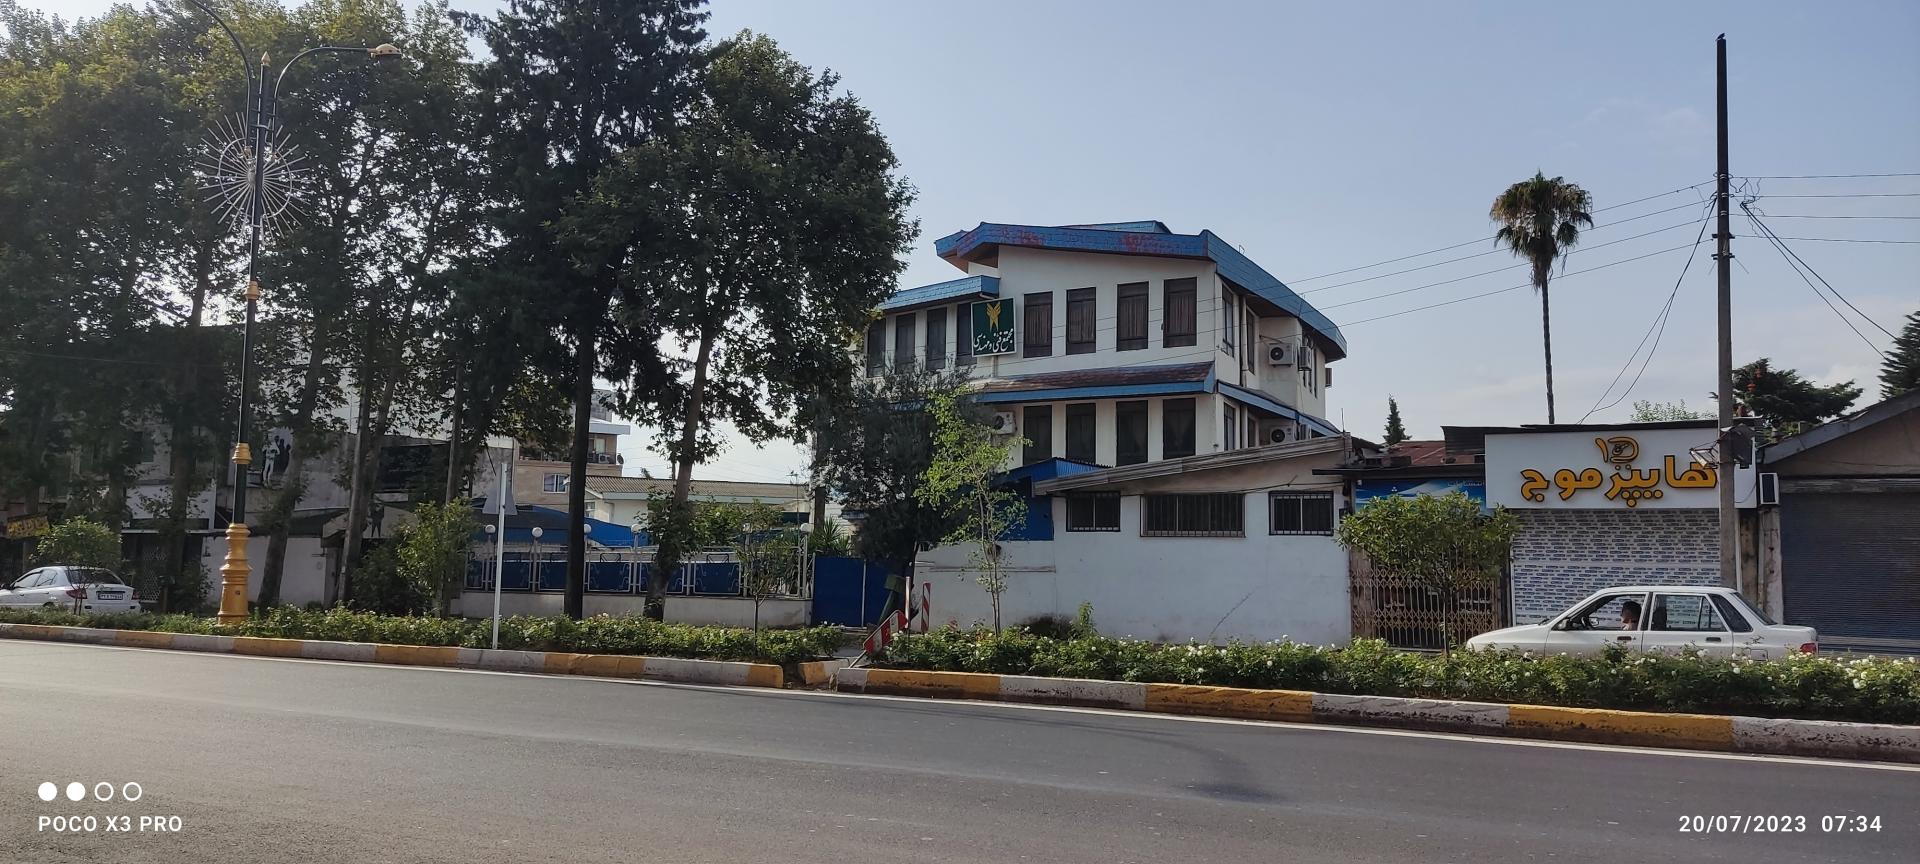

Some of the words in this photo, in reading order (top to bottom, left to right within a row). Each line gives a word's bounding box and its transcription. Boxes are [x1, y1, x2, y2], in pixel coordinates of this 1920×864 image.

[973, 333, 990, 352] مهندسی
[1000, 328, 1013, 352] مجتمع
[1520, 467, 1604, 502] موج
